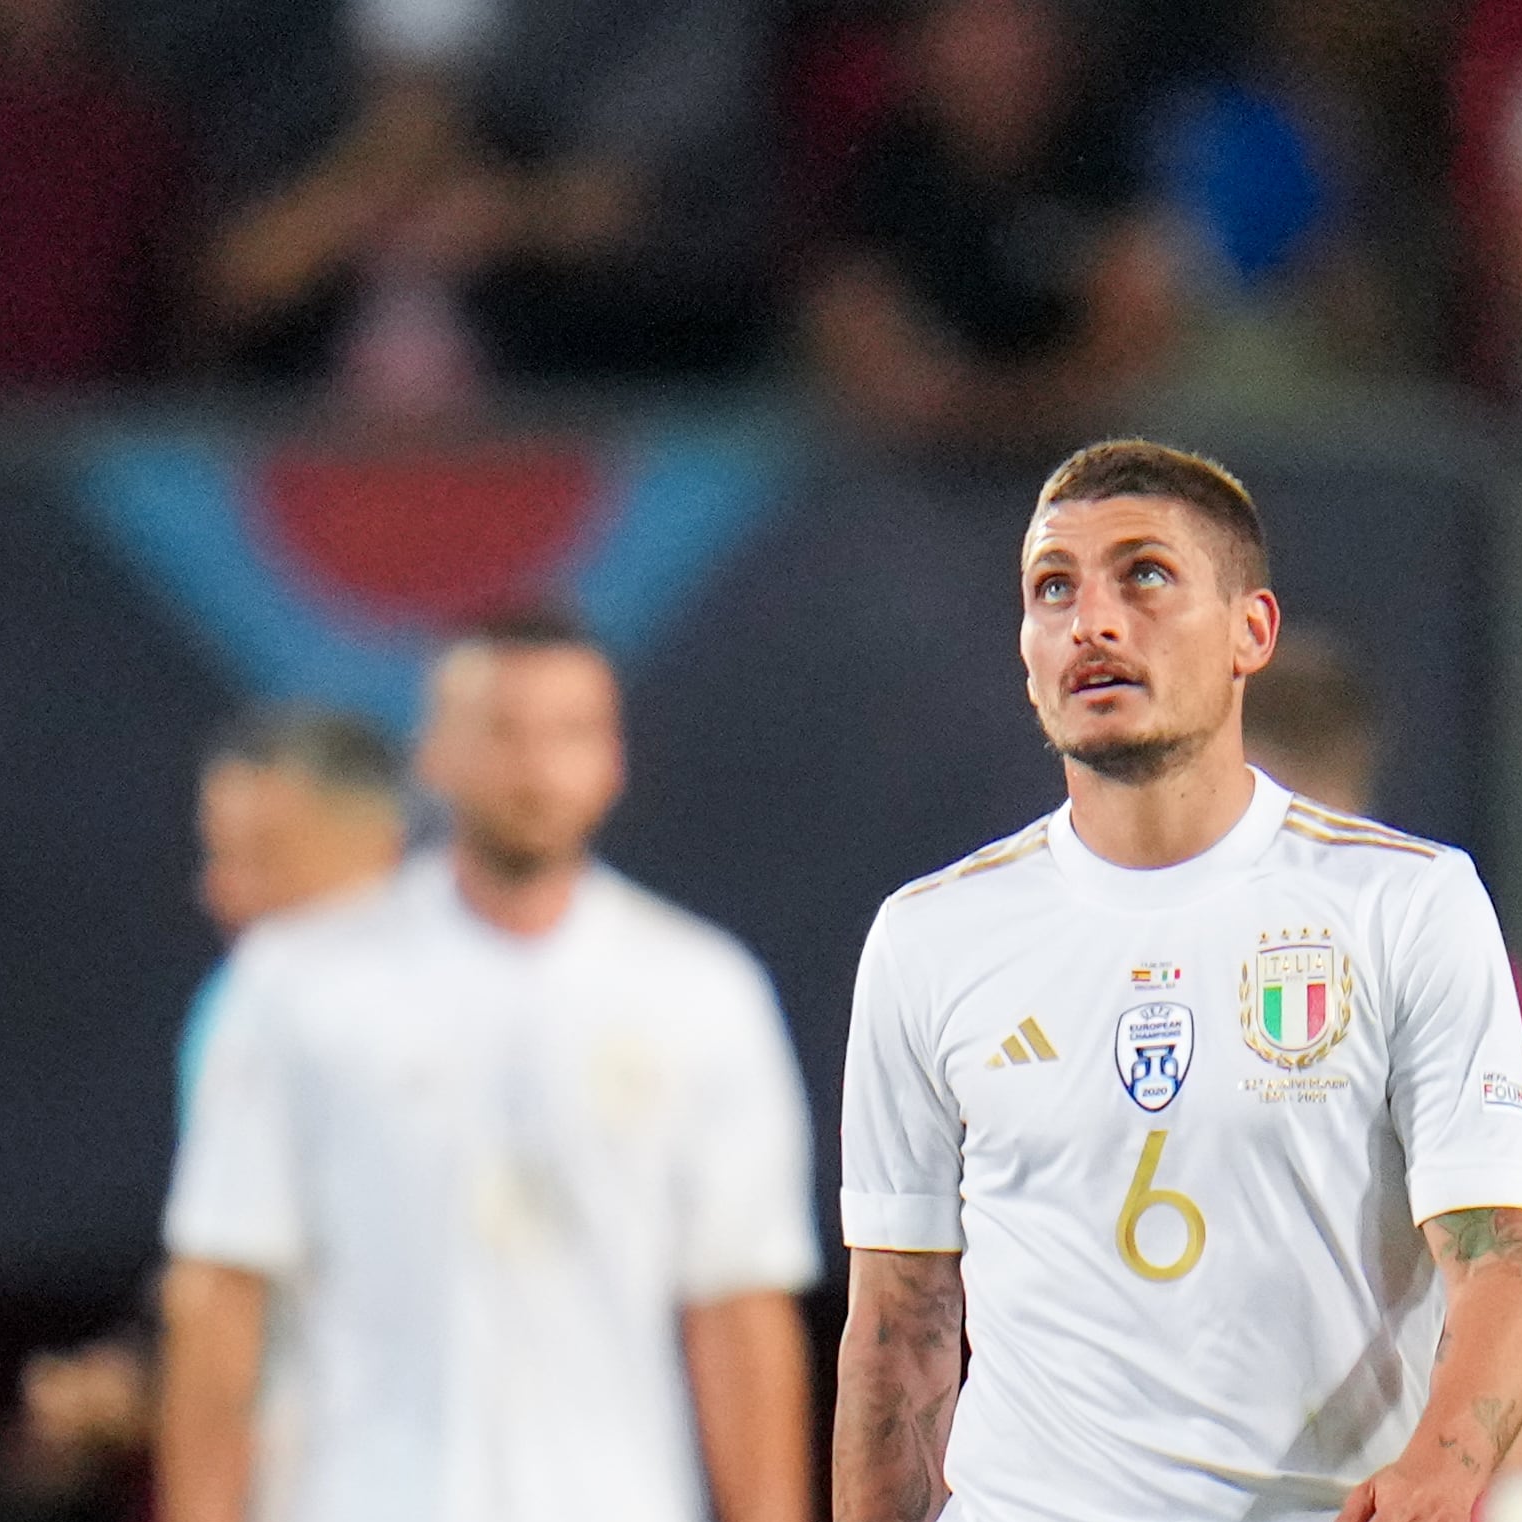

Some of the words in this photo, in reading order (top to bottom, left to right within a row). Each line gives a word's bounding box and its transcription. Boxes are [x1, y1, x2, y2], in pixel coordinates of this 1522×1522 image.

[1263, 953, 1325, 975] ITALIA
[1129, 1021, 1182, 1032] EUROPEAN
[1142, 1086, 1168, 1097] 2020
[1115, 1129, 1207, 1281] 6
